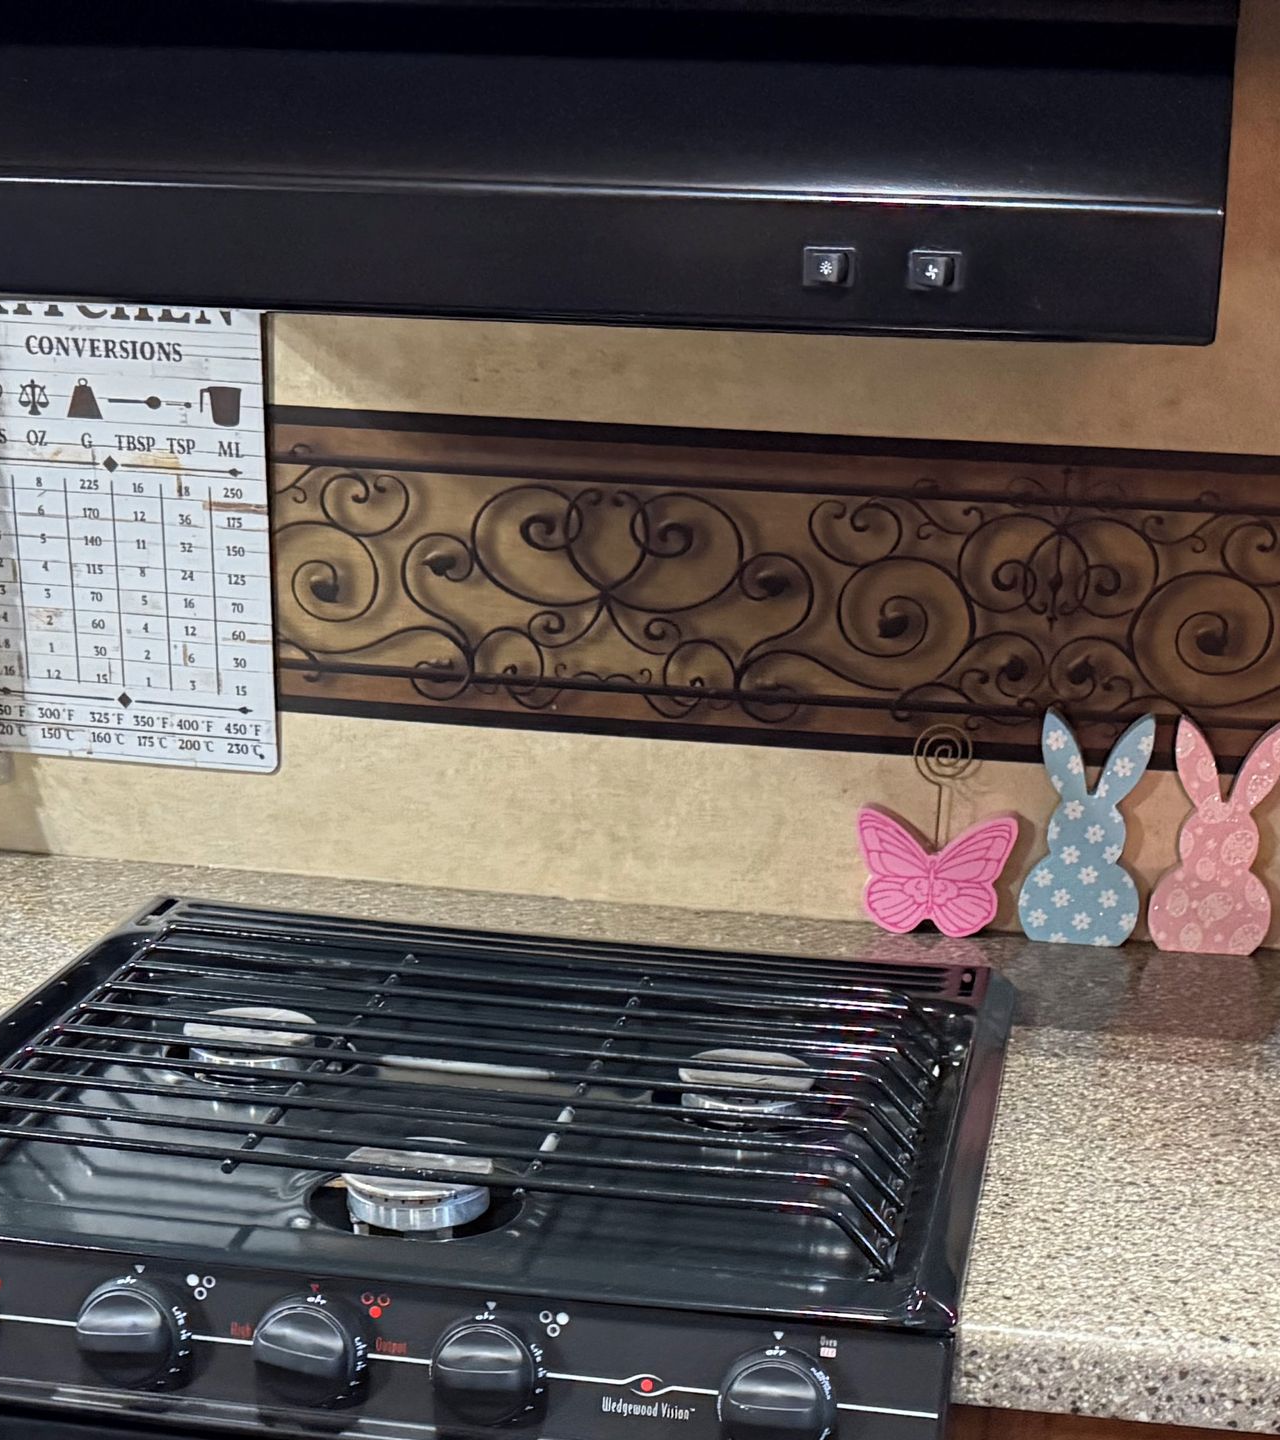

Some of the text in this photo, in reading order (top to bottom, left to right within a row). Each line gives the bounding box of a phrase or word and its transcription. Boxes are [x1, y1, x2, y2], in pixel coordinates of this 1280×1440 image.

[25, 335, 183, 362] CONVERSIONS
[27, 429, 48, 446] OZ
[81, 433, 93, 449] G
[115, 434, 156, 452] TBSP
[166, 437, 196, 455] TSP
[218, 441, 244, 458] ML
[79, 479, 99, 490] 225
[132, 482, 144, 493] 16
[223, 487, 243, 499] 250
[38, 504, 45, 516] 6
[82, 507, 99, 519] 170
[133, 511, 146, 522] 12
[178, 514, 192, 526] 36
[226, 517, 243, 528] 175
[84, 536, 102, 546] 140
[180, 542, 193, 553] 32
[226, 546, 245, 557] 150
[181, 570, 195, 581] 24
[228, 574, 246, 586] 125
[90, 591, 103, 602] 70
[183, 598, 195, 609] 16
[231, 602, 244, 613] 70
[91, 619, 105, 630] 60
[184, 626, 197, 636] 12
[231, 630, 246, 642] 60
[93, 646, 107, 656] 30
[144, 650, 151, 660] 2
[233, 657, 247, 668] 30
[96, 673, 108, 684] 15
[235, 686, 247, 696] 15
[602, 1396, 659, 1417] Wedgewood
